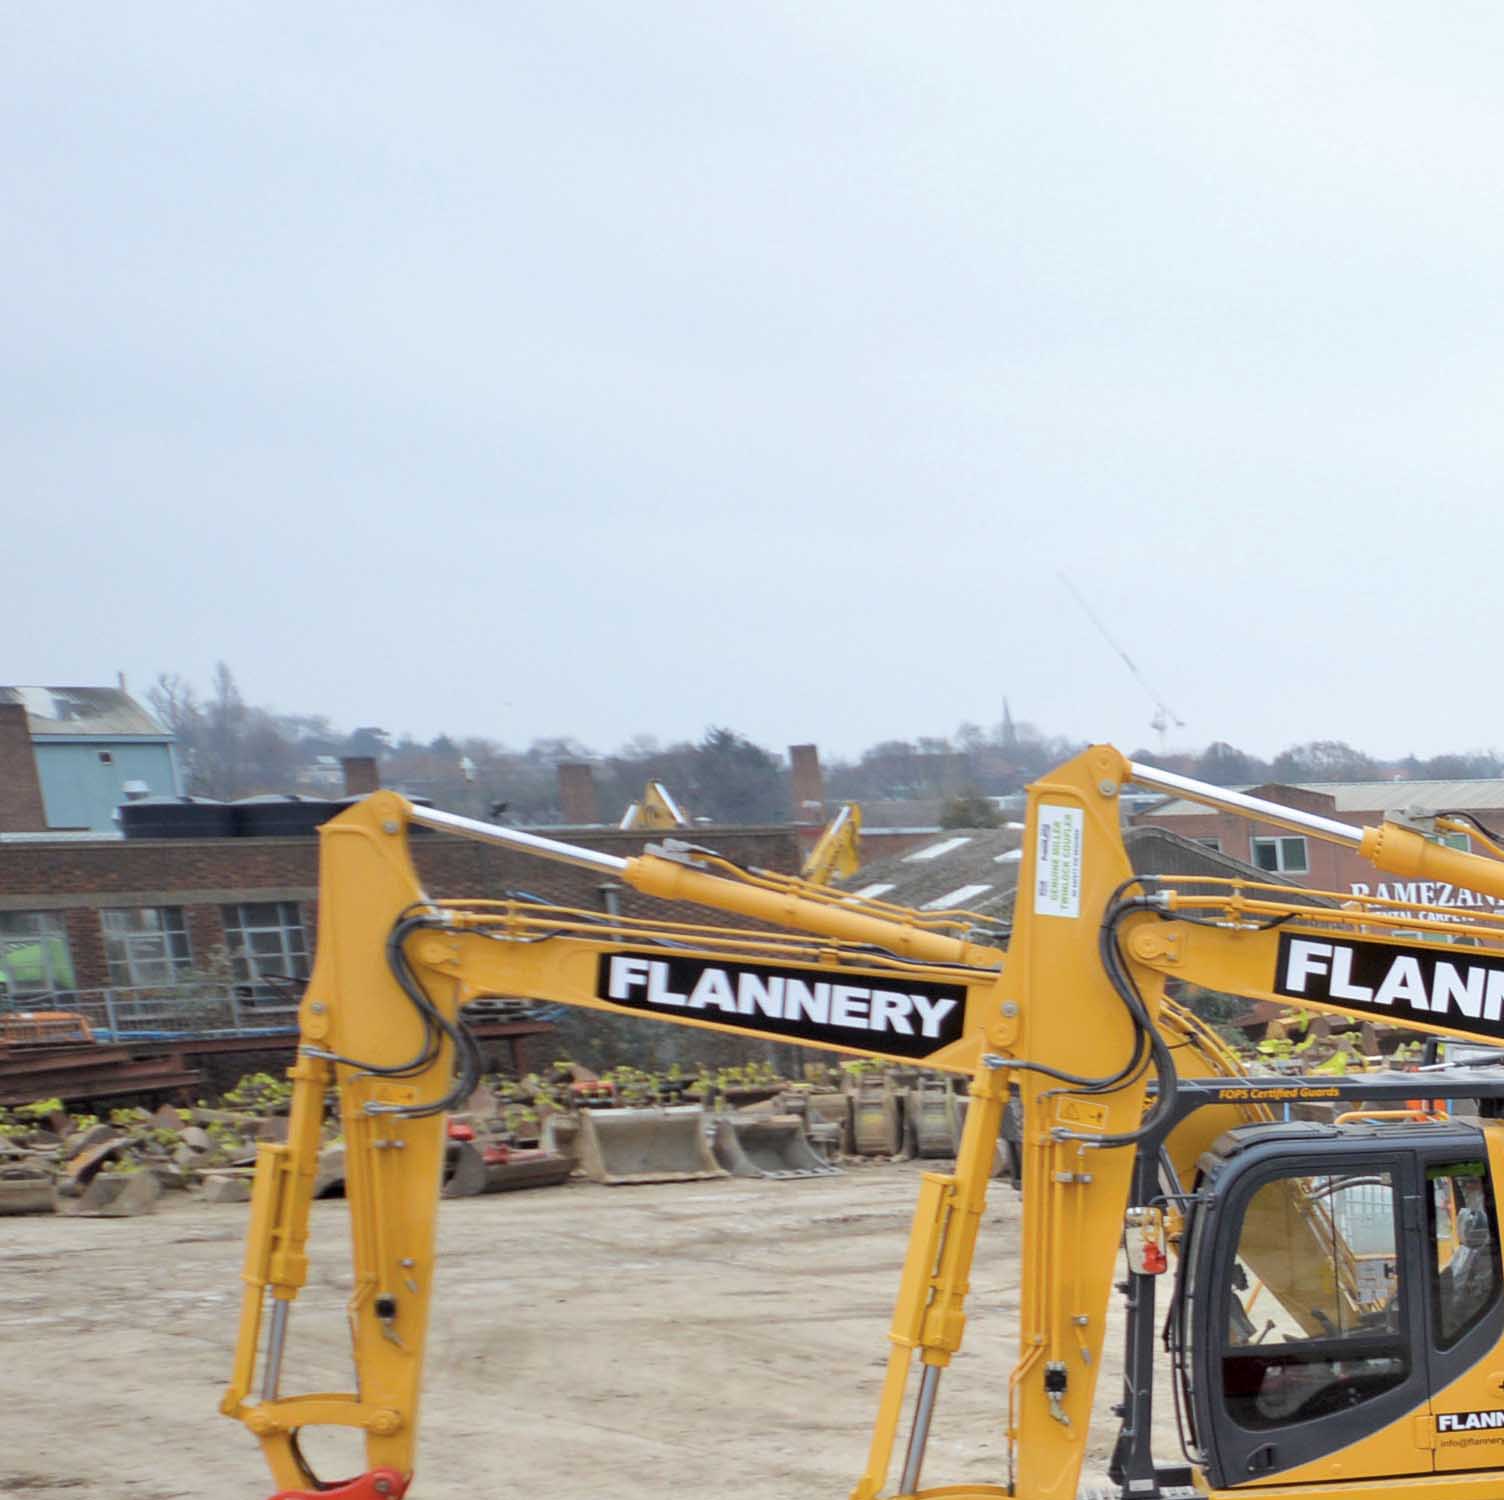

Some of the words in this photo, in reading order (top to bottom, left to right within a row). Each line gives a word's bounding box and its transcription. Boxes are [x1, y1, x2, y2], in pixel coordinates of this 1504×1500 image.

[608, 955, 957, 1038] FLANNERY
[1250, 1088, 1298, 1101] Certified
[1300, 1086, 1340, 1097] Guards
